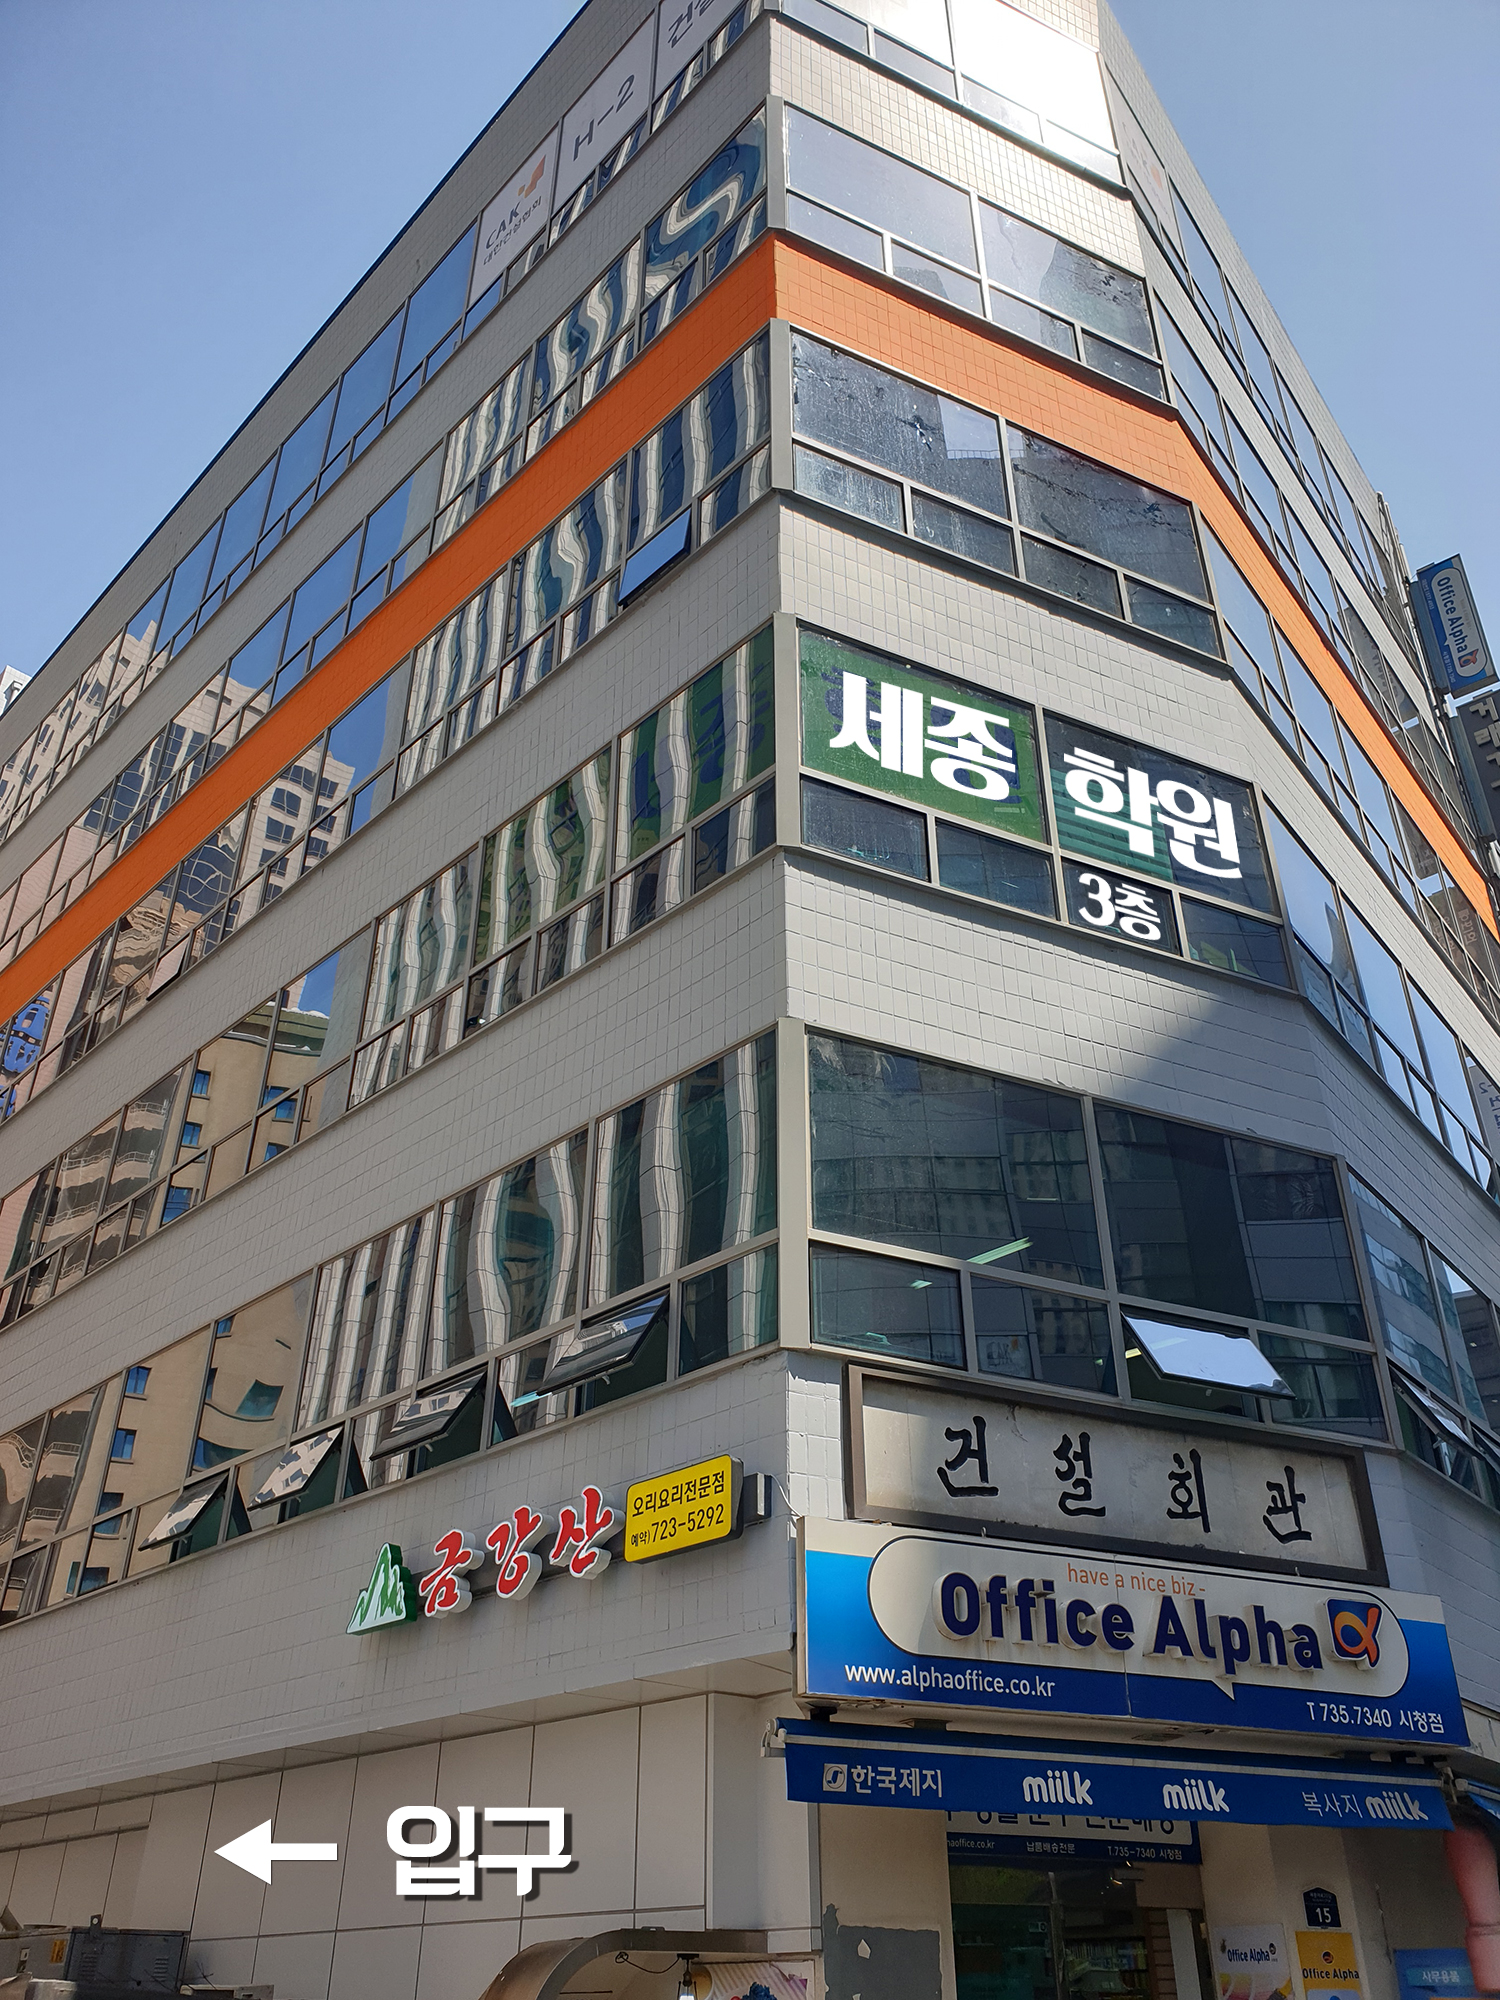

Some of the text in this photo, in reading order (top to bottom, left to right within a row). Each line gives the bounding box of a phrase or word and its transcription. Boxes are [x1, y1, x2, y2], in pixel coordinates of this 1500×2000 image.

[486, 202, 520, 250] CAK
[1437, 576, 1456, 615] Office
[1448, 616, 1468, 654] Alpha
[830, 671, 1016, 801] 세종
[1064, 747, 1242, 879] 학원
[1078, 872, 1161, 941] 3층
[632, 1470, 725, 1517] 오리요리전문점
[418, 1484, 616, 1617] 금강산
[1067, 1562, 1109, 1587] have
[1115, 1571, 1125, 1588] a
[1131, 1571, 1166, 1593] nice
[1171, 1575, 1195, 1596] biz
[938, 1571, 1136, 1651] Office
[1152, 1594, 1323, 1676] Alpha
[845, 1665, 1056, 1698] www.alphaoffice.co.kr
[1319, 1702, 1392, 1728] 735.7340
[1399, 1709, 1445, 1734] 시청점
[851, 1764, 943, 1799] 한국제지
[1023, 1769, 1093, 1806] miilk
[1162, 1778, 1230, 1813] miilk
[1303, 1791, 1429, 1822] 복사지 miilk
[1315, 1907, 1332, 1924] 15
[1227, 1948, 1270, 1965] Office Alpha
[1302, 1967, 1359, 1982] Office Alpha
